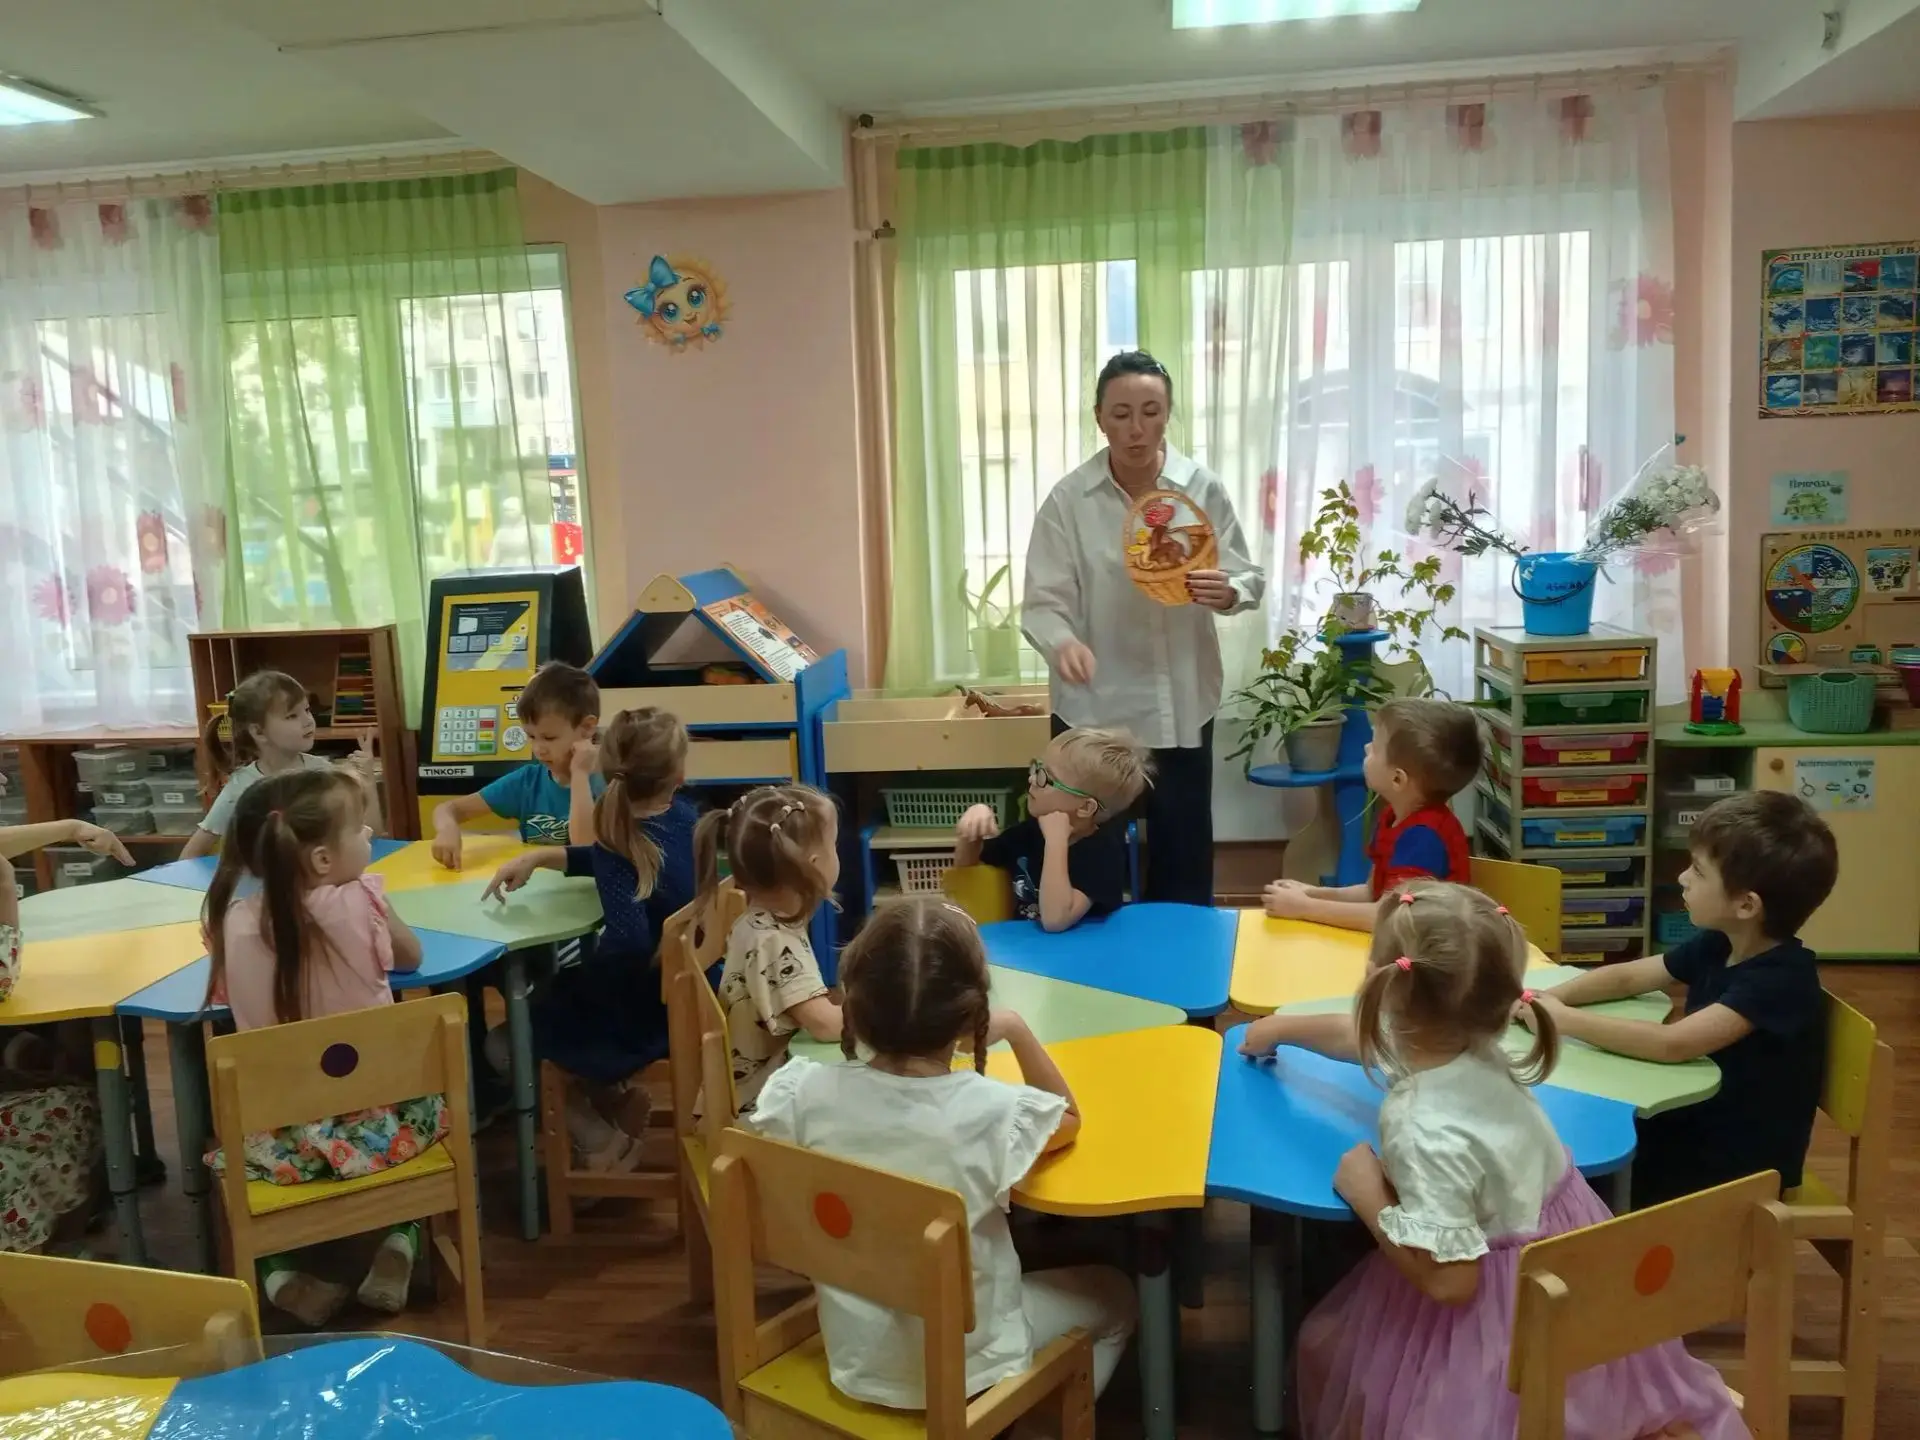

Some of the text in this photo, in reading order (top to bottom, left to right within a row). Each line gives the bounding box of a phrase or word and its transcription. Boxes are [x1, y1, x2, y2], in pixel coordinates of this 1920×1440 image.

[1791, 248, 1891, 262] ПРИРОДНЫЕ
[1800, 530, 1882, 541] КАЛЕНДАРЬ
[424, 768, 467, 776] TINKOFF
